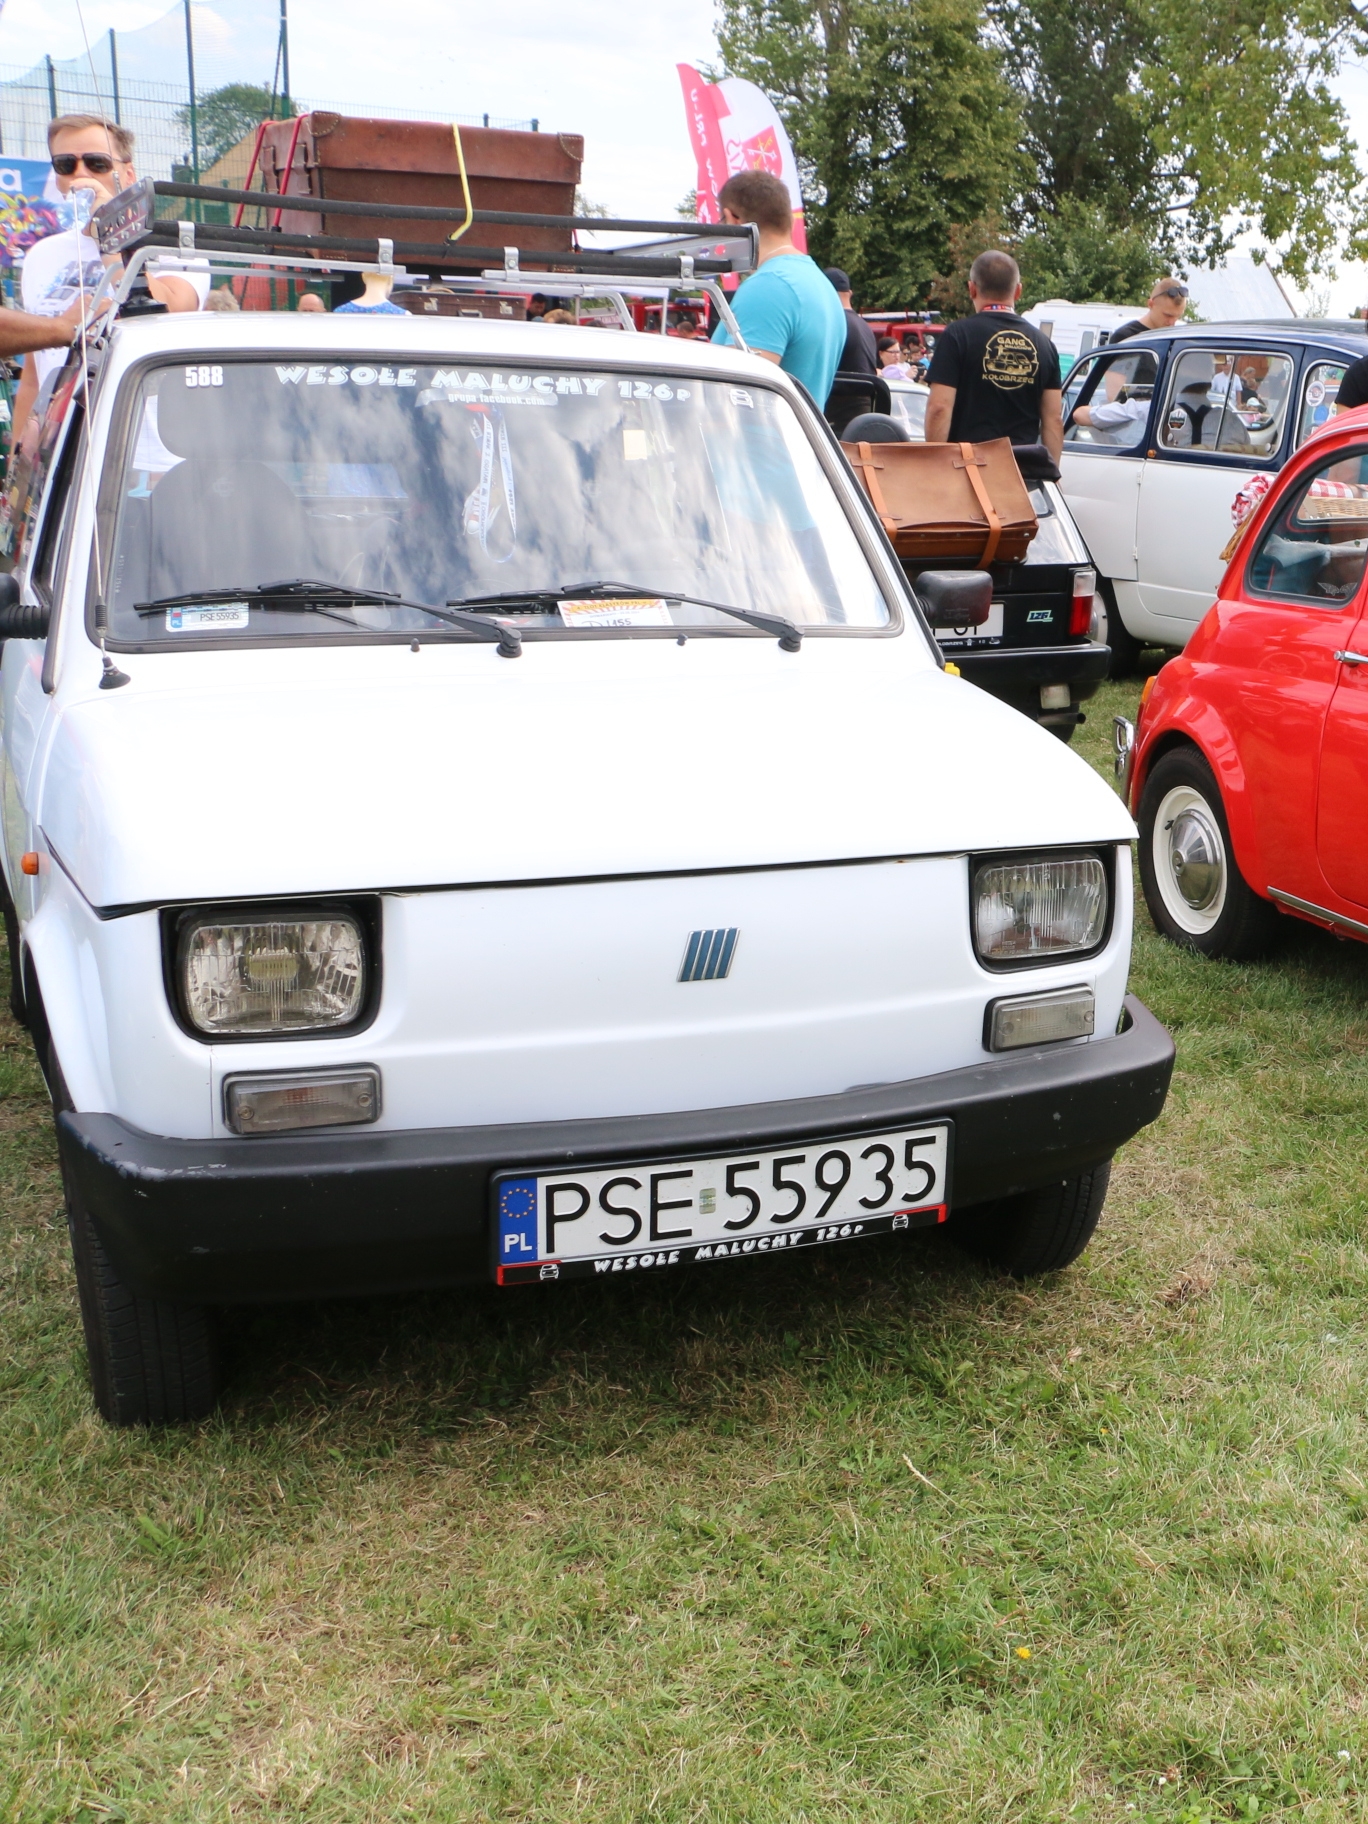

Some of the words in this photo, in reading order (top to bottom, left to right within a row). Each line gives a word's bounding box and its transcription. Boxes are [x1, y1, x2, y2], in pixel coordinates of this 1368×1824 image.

[997, 336, 1026, 346] GANG
[186, 365, 224, 388] 588
[274, 365, 417, 387] WESOŁE
[430, 368, 607, 397] MALUCHY
[982, 373, 1035, 384] KOŁOBRZEG
[448, 393, 477, 403] grupa
[480, 393, 546, 406] facebook.com
[200, 613, 215, 621] PSE
[216, 612, 240, 620] 55935
[545, 1169, 694, 1254] PSE
[723, 1135, 938, 1231] 55935
[503, 1232, 533, 1254] PL
[593, 1250, 681, 1273] WESOŁE
[694, 1231, 804, 1260] MALUCHY
